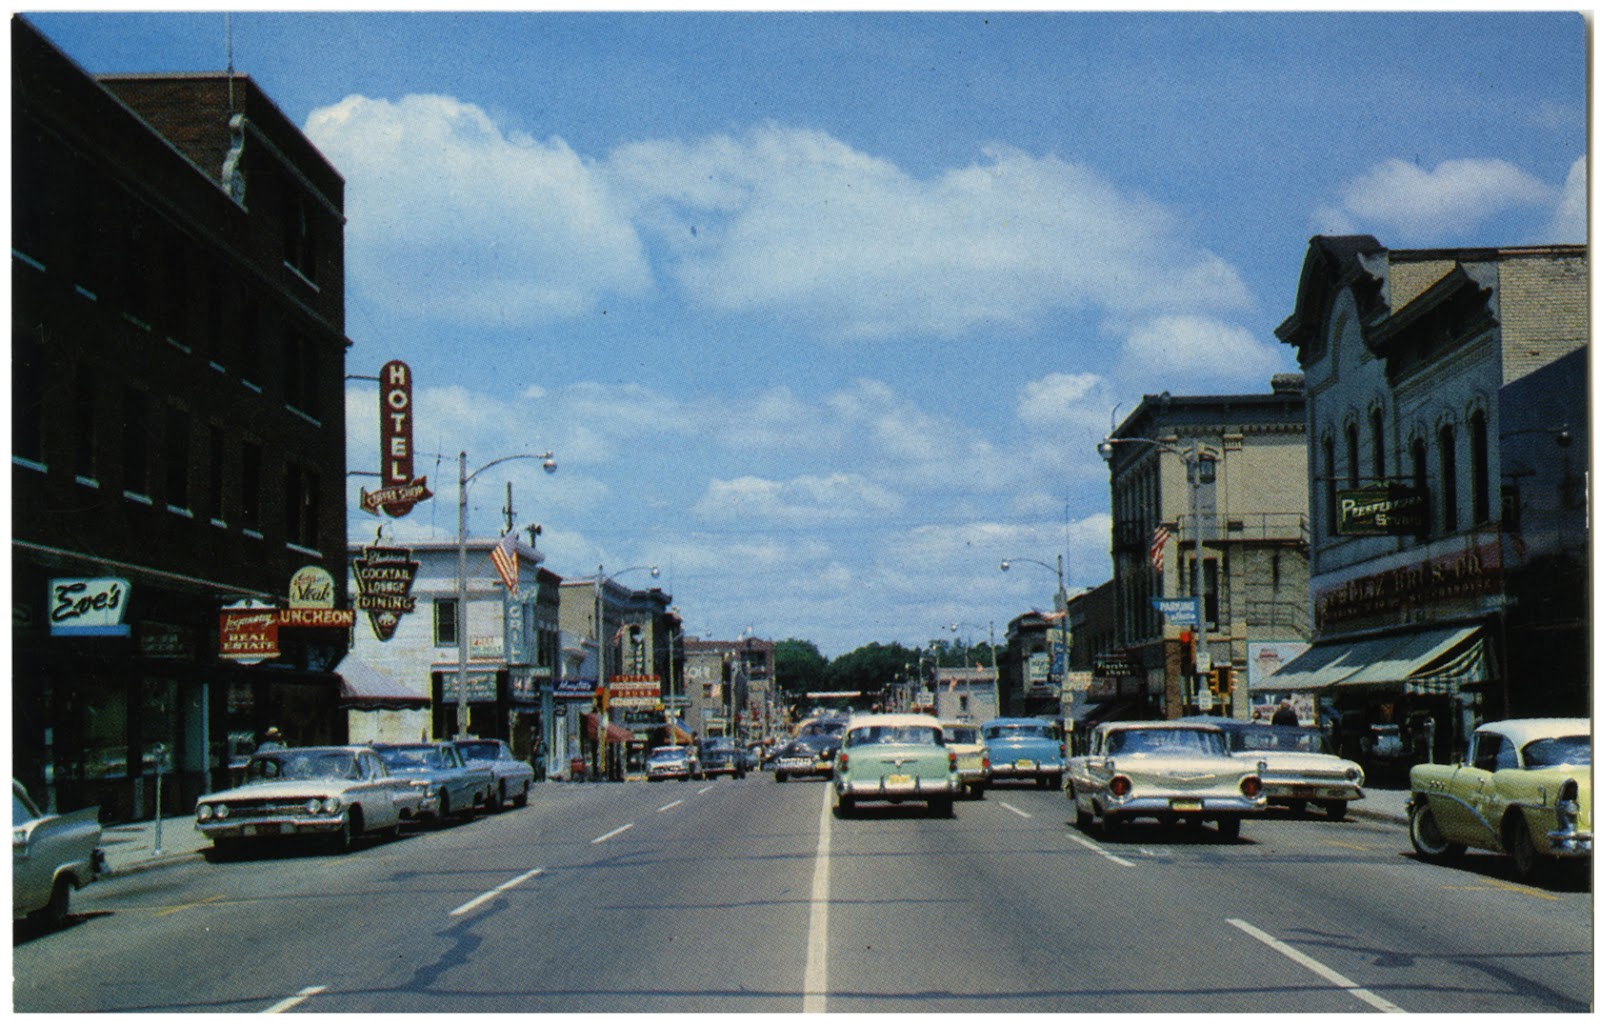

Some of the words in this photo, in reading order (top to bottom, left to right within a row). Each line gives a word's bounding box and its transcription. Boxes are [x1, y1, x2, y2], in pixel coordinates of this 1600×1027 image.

[388, 365, 408, 481] HOTEL
[399, 484, 424, 502] SHOP
[361, 567, 412, 579] COCKTAIL
[368, 580, 406, 594] LOUNGE
[52, 582, 121, 622] Eve's
[361, 596, 413, 609] DINING
[279, 609, 353, 624] UNCHEON
[228, 633, 268, 642] REAL
[223, 641, 275, 650] ESTATE
